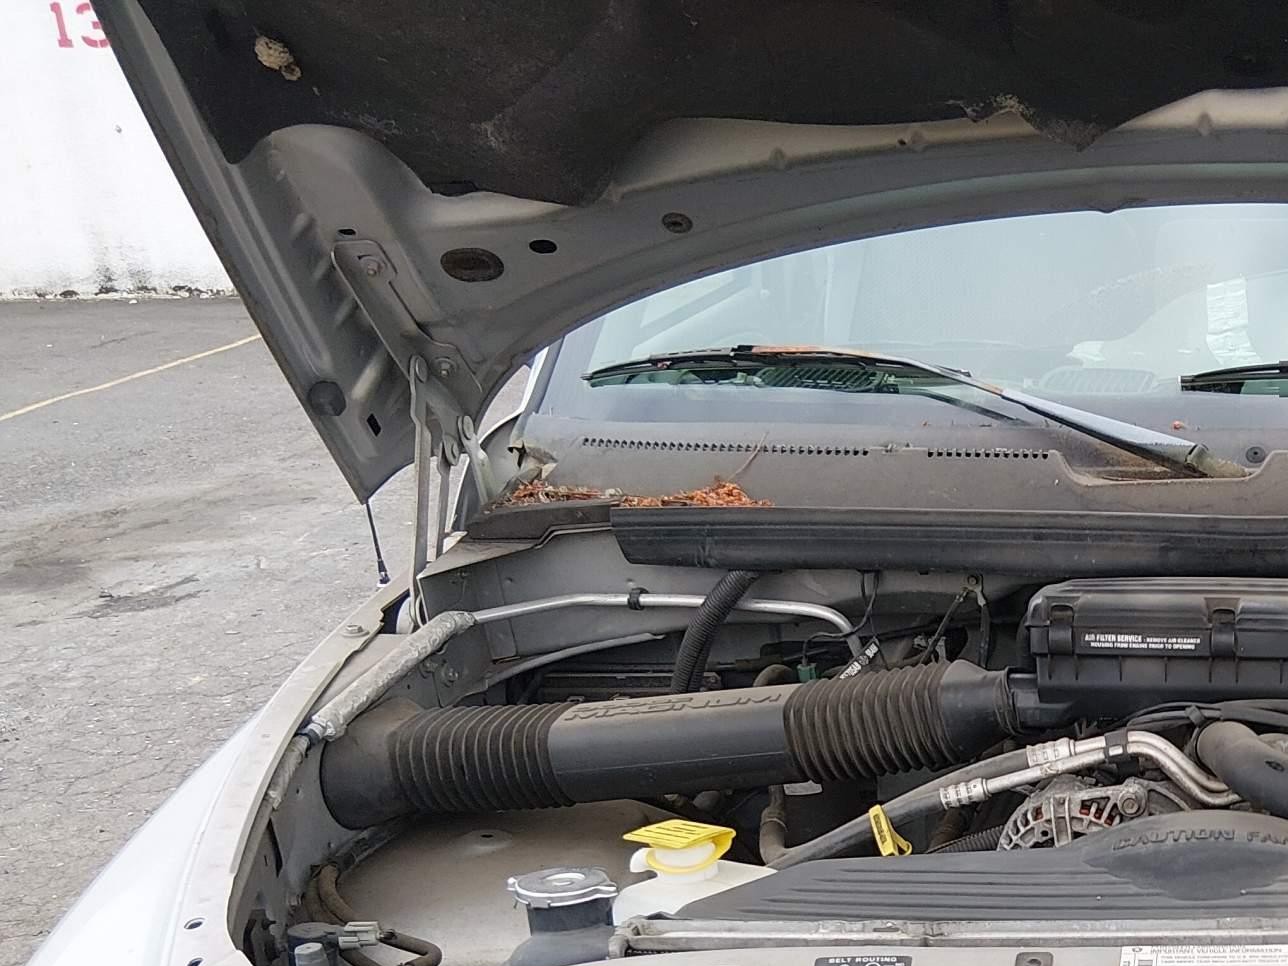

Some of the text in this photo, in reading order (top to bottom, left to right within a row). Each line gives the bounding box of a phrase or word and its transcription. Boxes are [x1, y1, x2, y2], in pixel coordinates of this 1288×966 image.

[50, 2, 110, 48] 13
[1096, 634, 1117, 642] FILTER
[1117, 635, 1142, 643] SERVICE
[1112, 828, 1237, 851] CAUTION
